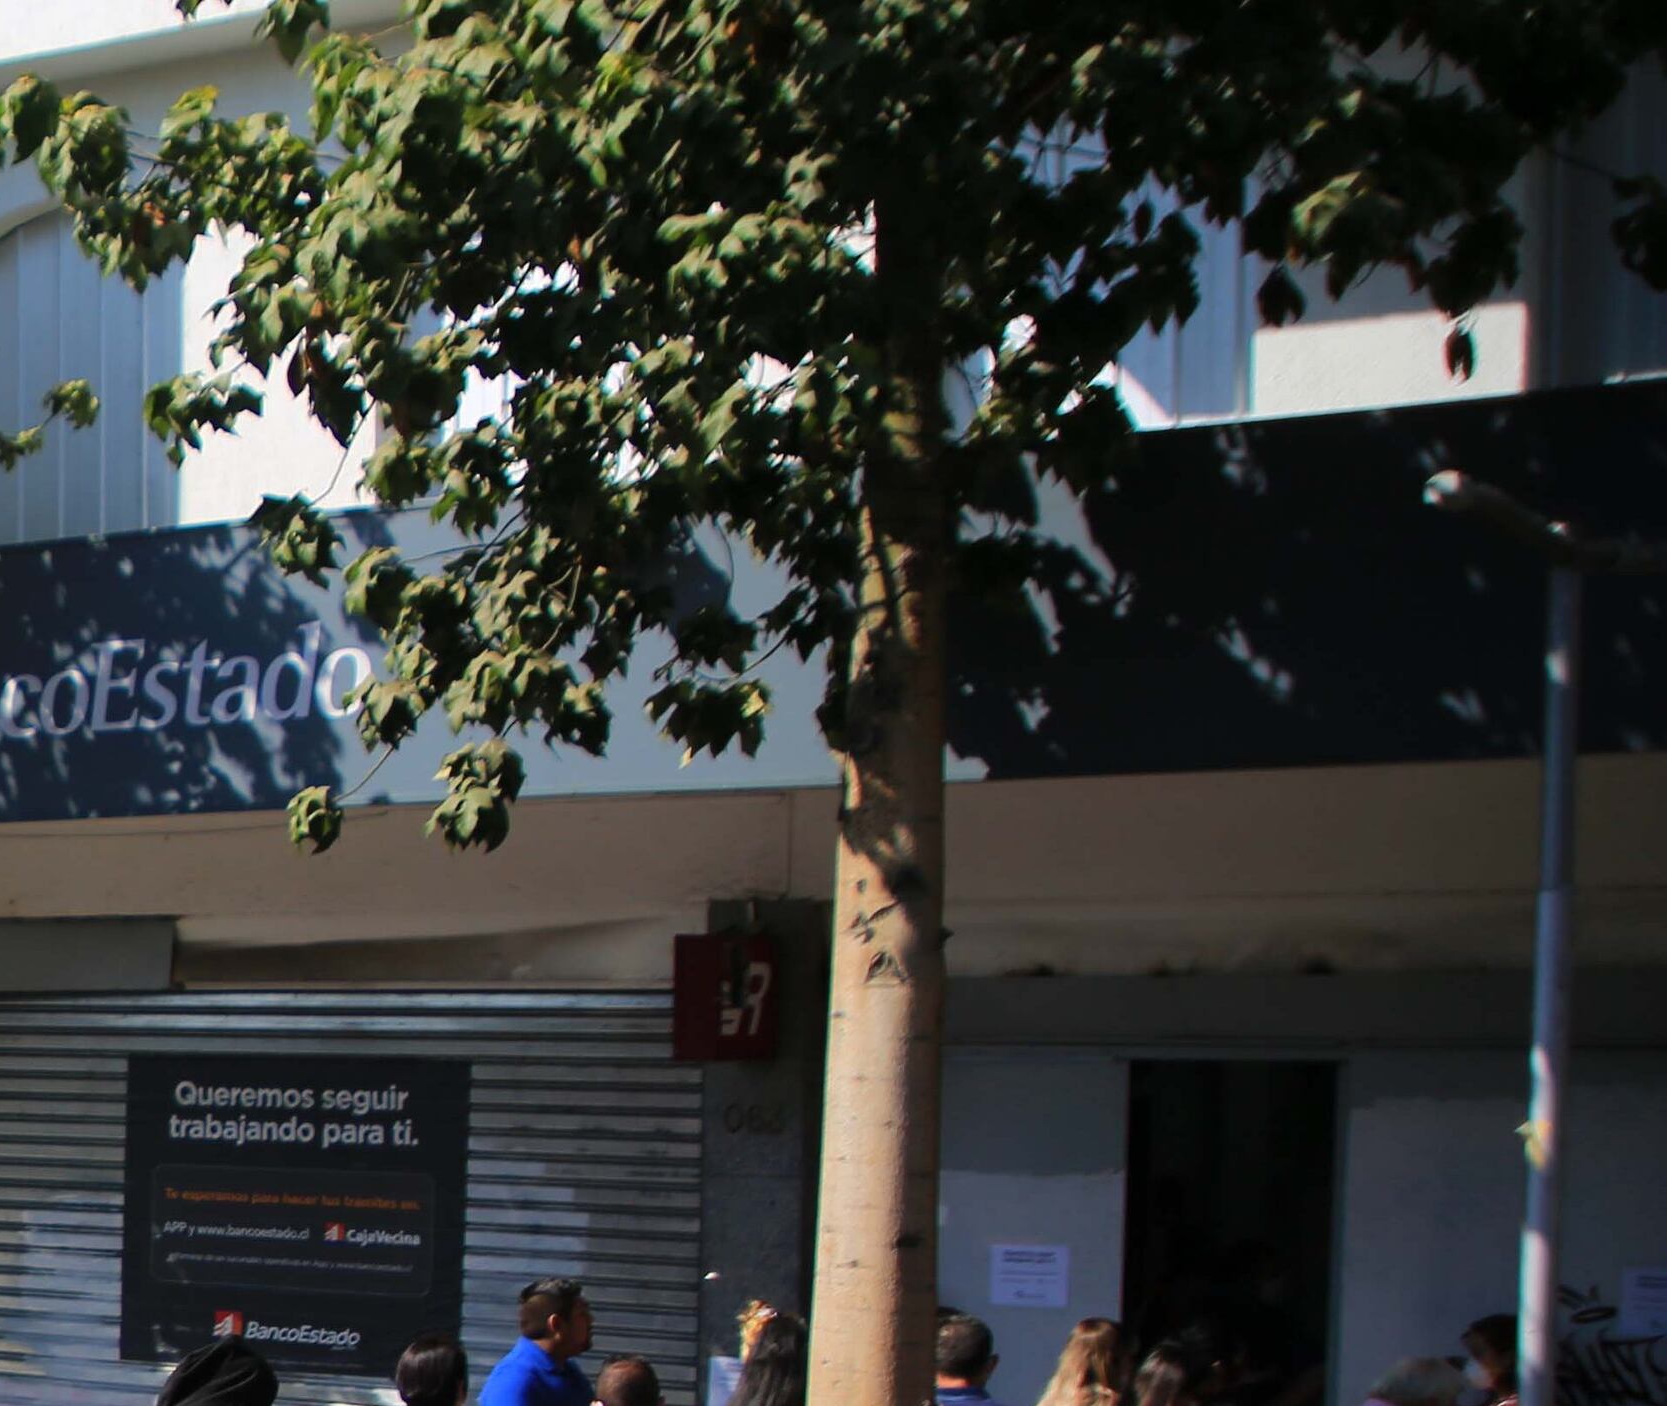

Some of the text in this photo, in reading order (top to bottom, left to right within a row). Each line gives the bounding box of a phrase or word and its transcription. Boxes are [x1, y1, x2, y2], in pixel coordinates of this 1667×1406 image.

[174, 1080, 410, 1115] Queremos seguir
[168, 1113, 420, 1149] trabajando para ti.
[163, 1221, 187, 1233] APP
[188, 1225, 196, 1238] y
[345, 1229, 421, 1247] CajaVecina
[244, 1320, 362, 1346] BancoEstado
